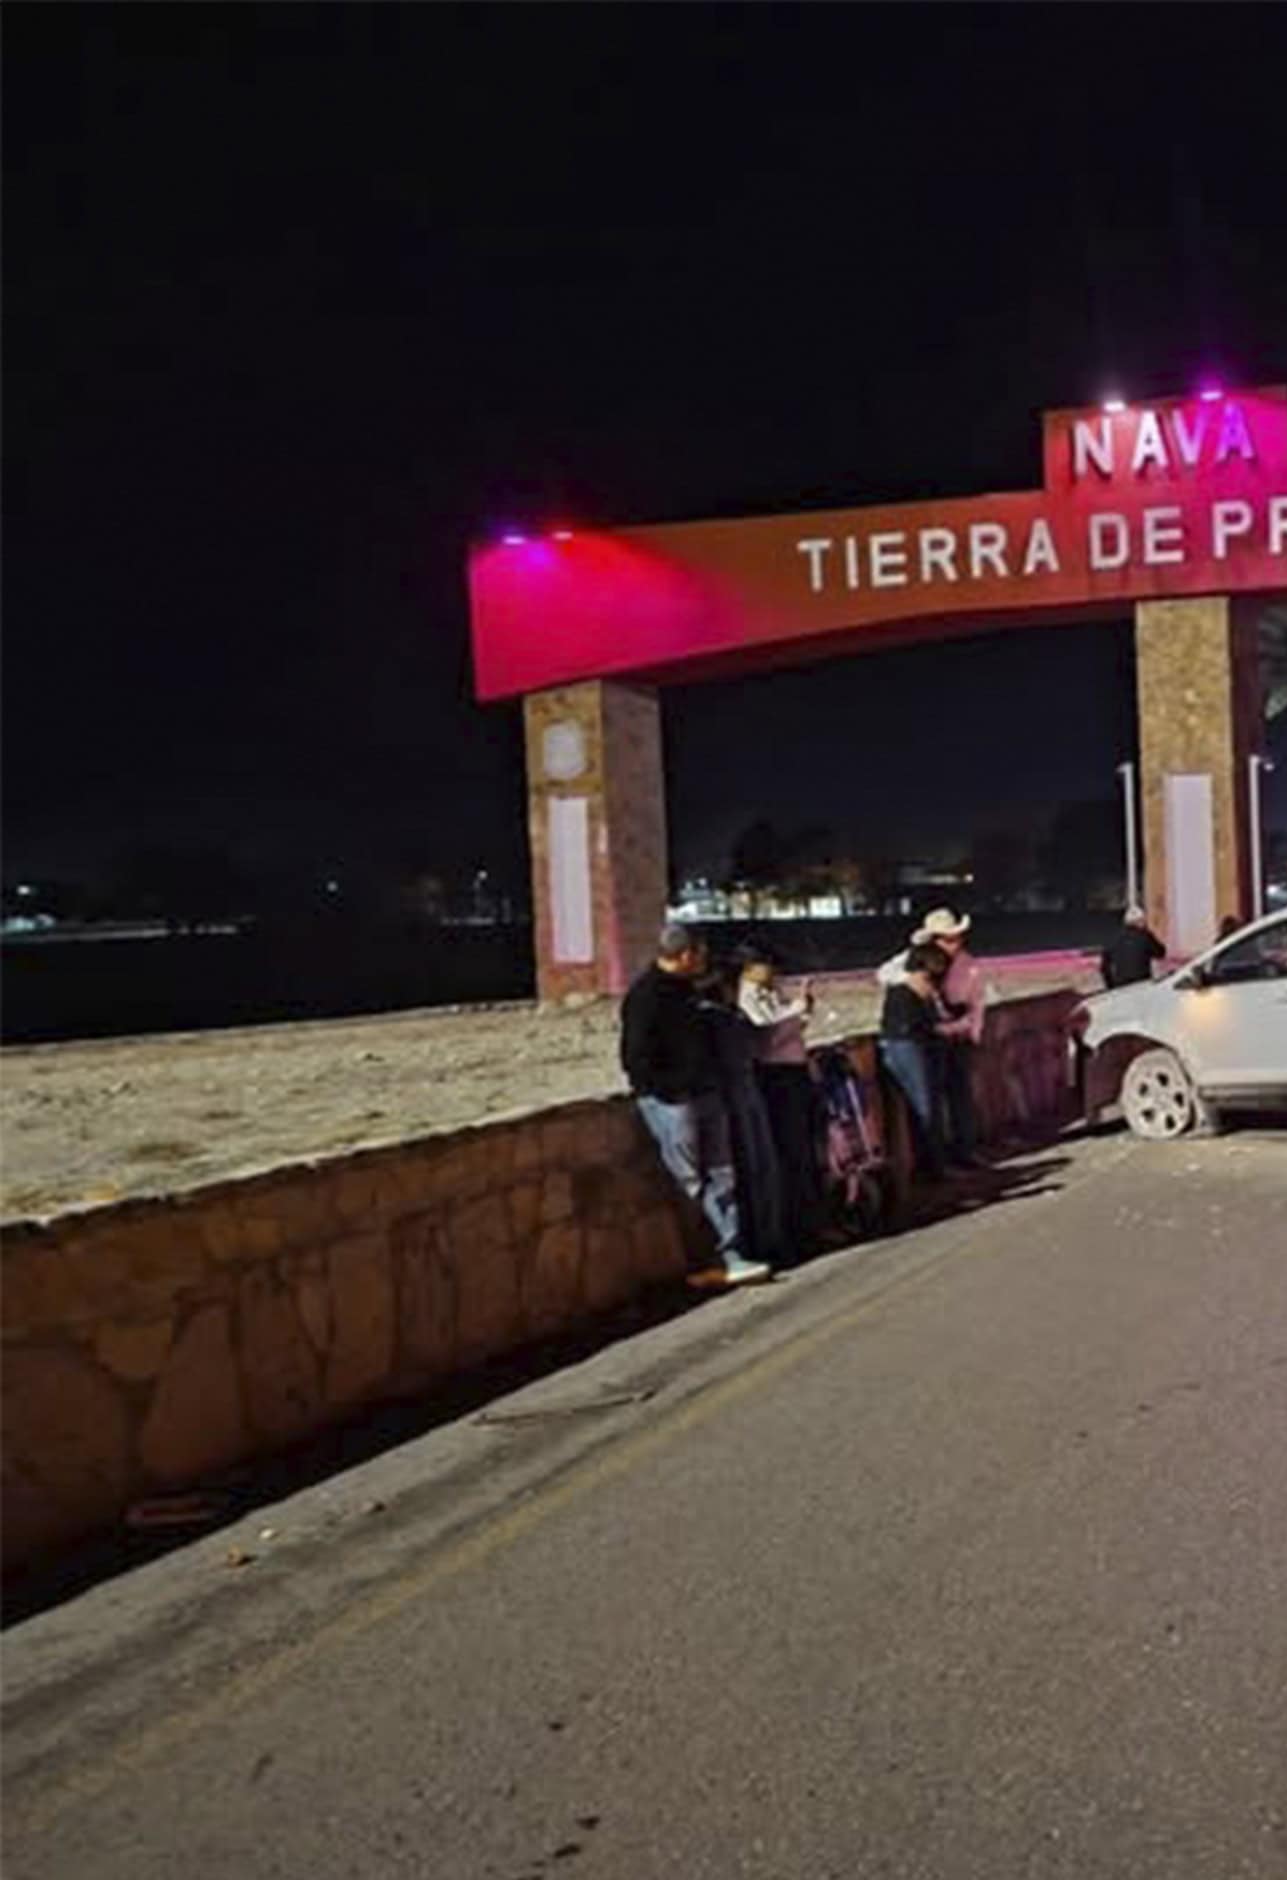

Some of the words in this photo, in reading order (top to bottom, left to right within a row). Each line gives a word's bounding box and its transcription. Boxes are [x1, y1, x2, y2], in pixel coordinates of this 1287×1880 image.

[1073, 405, 1257, 476] NAVA
[798, 518, 1060, 592] TIERRA
[1090, 507, 1184, 570] DE
